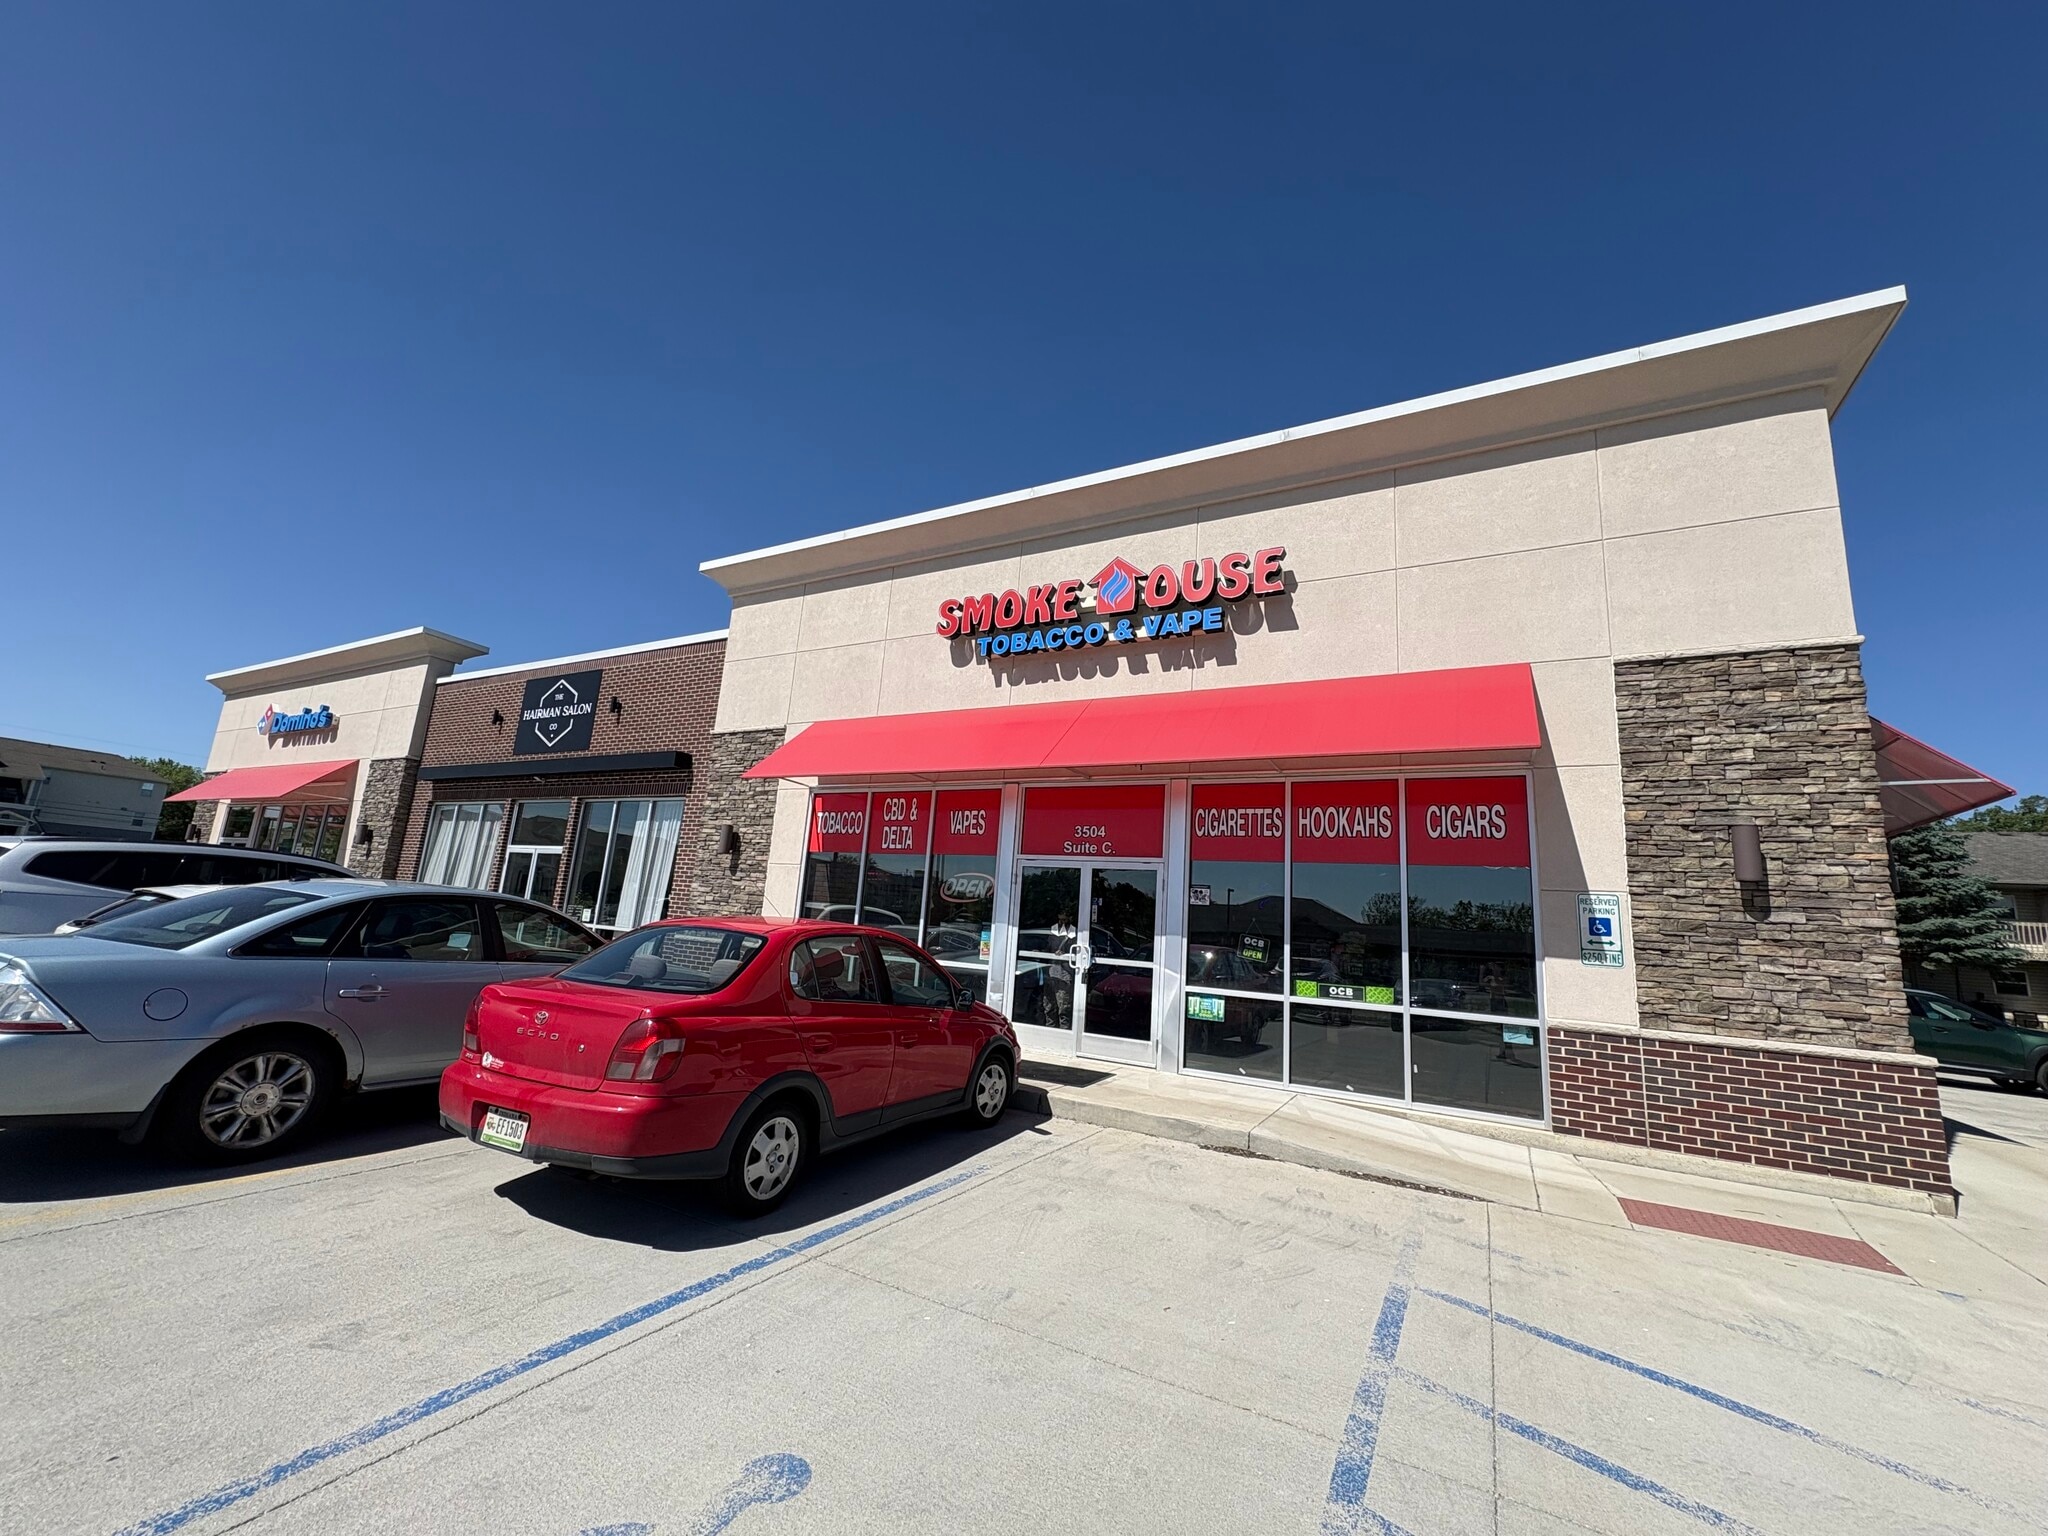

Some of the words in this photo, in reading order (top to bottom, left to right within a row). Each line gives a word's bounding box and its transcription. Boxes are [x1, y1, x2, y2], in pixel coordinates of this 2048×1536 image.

[936, 579, 1083, 639] SMOKE
[977, 622, 1105, 657] TOBACCO
[1113, 618, 1135, 641] &
[1142, 606, 1223, 637] VAPE
[555, 693, 564, 701] THE
[271, 705, 331, 733] Domino's
[523, 706, 561, 721] HAIRMAN
[562, 702, 592, 716] SALON
[549, 723, 557, 731] CO
[883, 797, 906, 821] CBD
[909, 797, 918, 821] &
[817, 811, 863, 835] TOBACCO
[950, 809, 986, 835] VAPES
[1195, 807, 1283, 838] CIGARETTES
[1298, 806, 1393, 839] HOOKAHS
[1426, 803, 1507, 839] CIGARS
[882, 826, 913, 850] DELTA
[1074, 825, 1106, 838] 3504
[1063, 841, 1097, 854] Suite
[943, 878, 992, 898] OPEN
[1580, 897, 1618, 906] RESERVED
[1582, 907, 1616, 915] PARKING
[1244, 937, 1265, 948] OCB
[1242, 948, 1263, 960] OPEN
[1605, 953, 1622, 964] FINE
[1329, 986, 1354, 996] OCB
[516, 1027, 560, 1041] ECHO
[495, 1117, 524, 1140] EF1503
